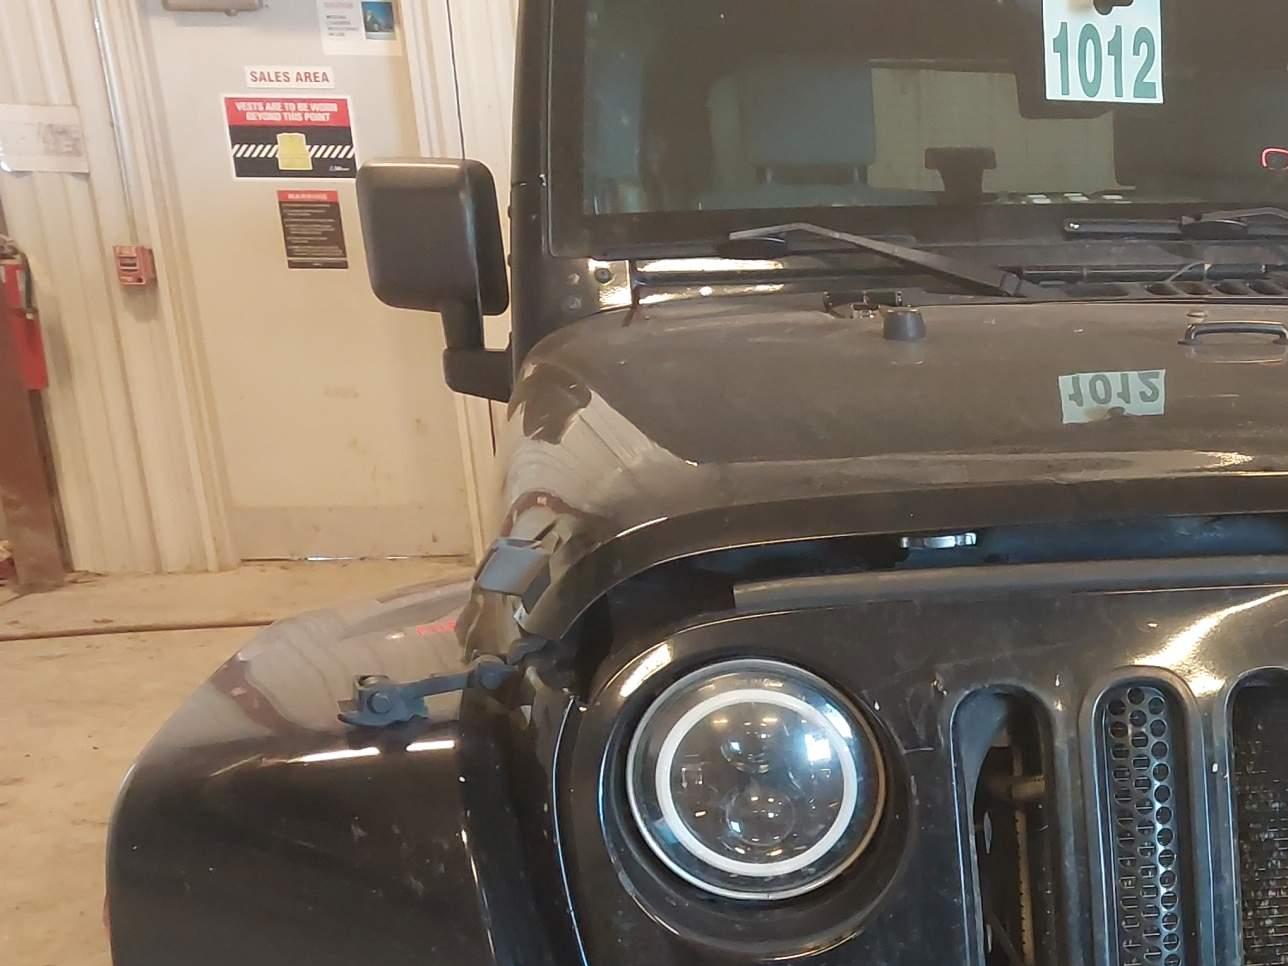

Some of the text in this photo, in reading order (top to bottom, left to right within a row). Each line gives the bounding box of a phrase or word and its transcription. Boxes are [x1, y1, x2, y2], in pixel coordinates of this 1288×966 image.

[249, 71, 330, 82] SALES AREA
[1052, 21, 1157, 99] 1012
